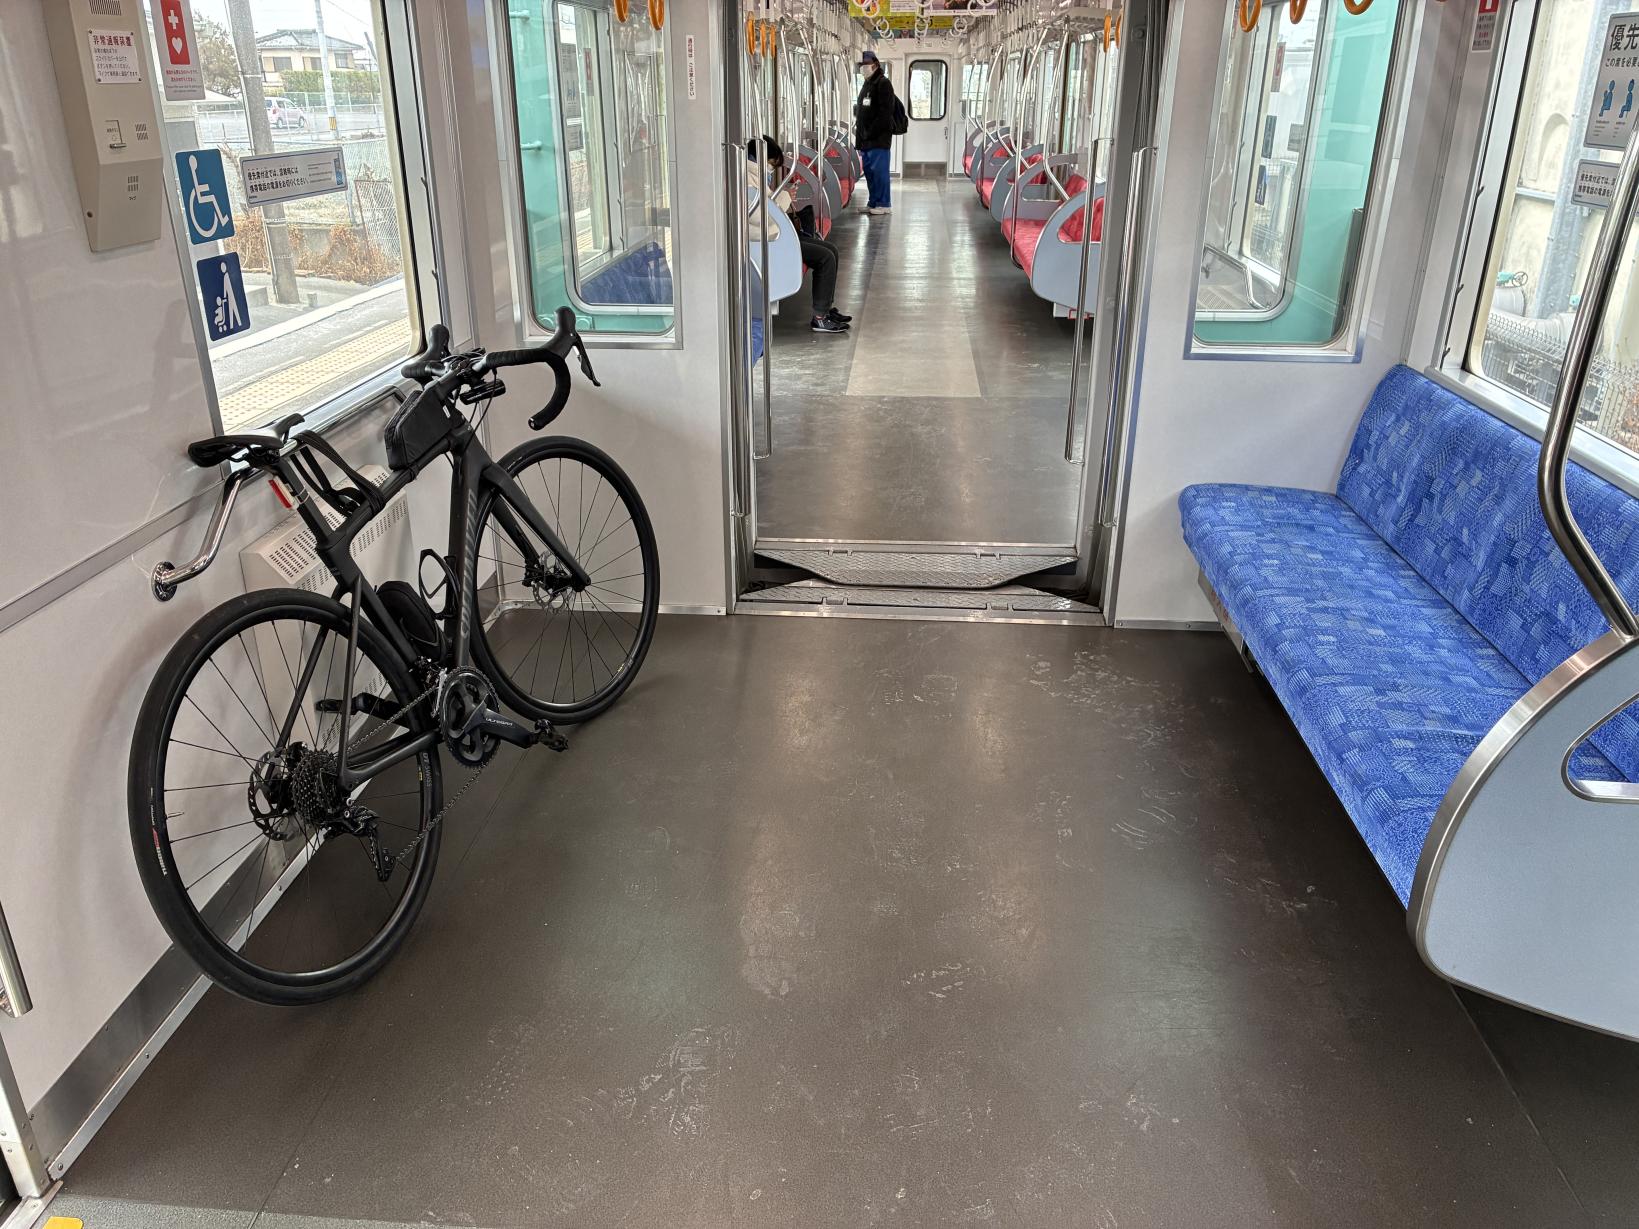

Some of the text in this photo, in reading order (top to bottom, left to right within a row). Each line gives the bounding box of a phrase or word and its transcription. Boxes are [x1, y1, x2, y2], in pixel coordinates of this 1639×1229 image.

[93, 35, 132, 46] 非常通報装置
